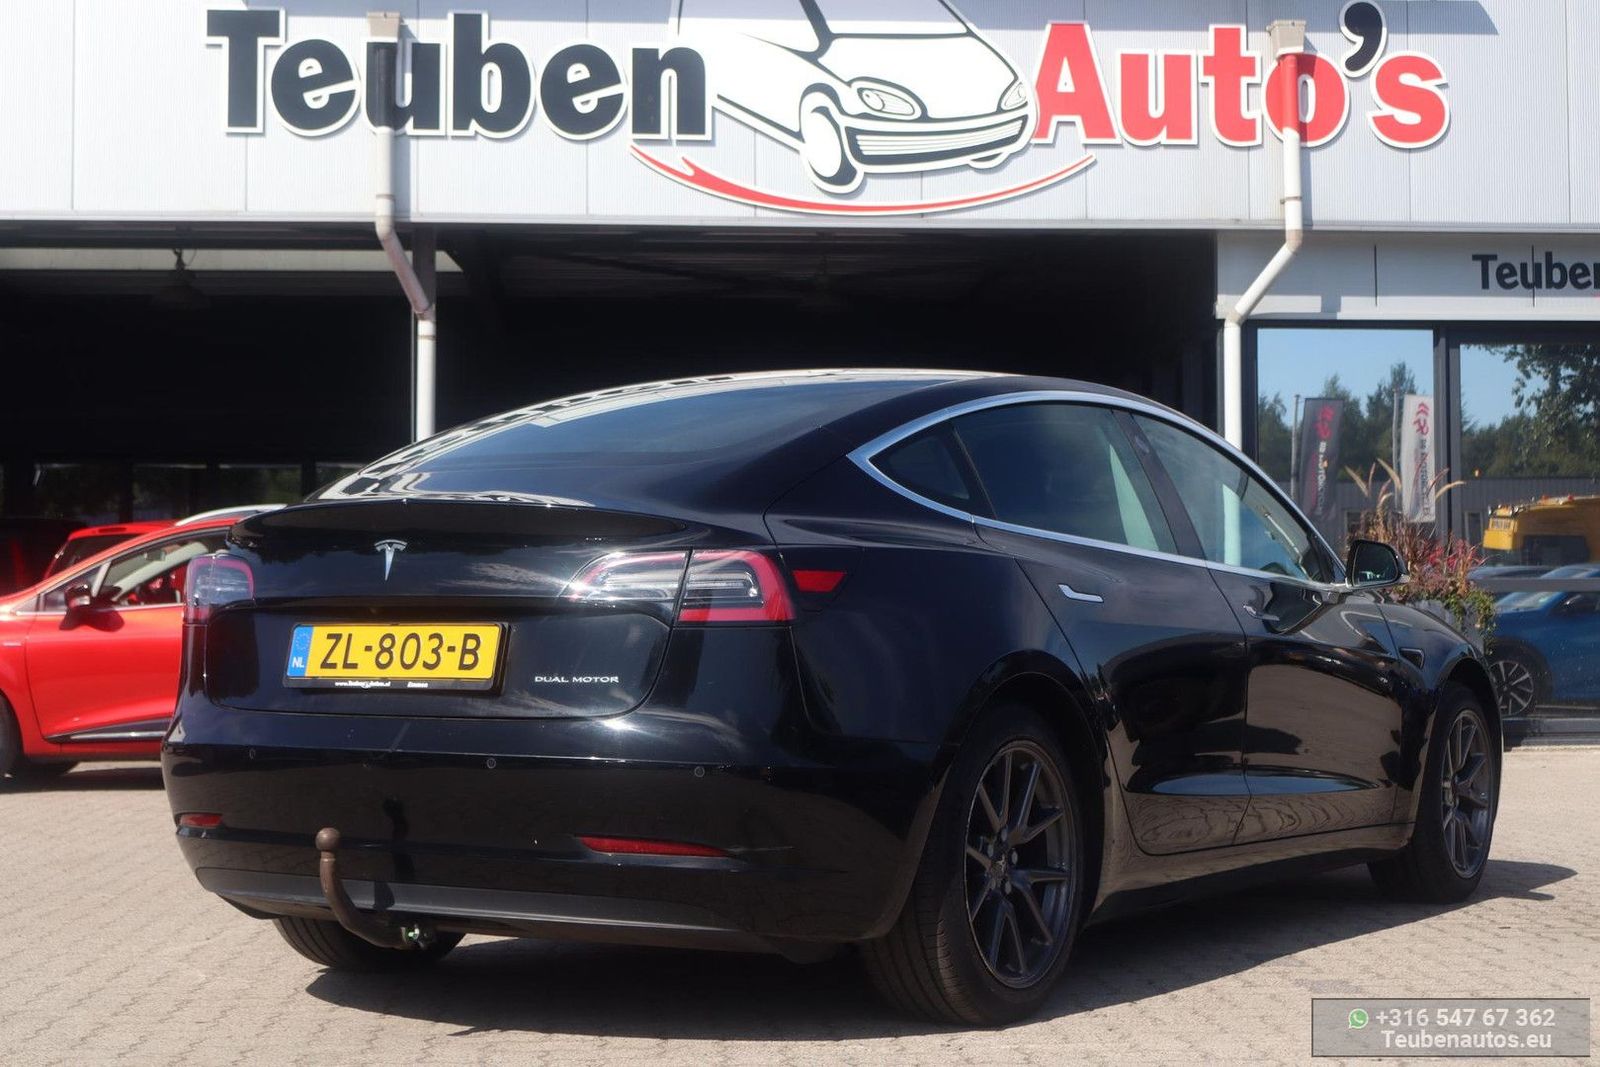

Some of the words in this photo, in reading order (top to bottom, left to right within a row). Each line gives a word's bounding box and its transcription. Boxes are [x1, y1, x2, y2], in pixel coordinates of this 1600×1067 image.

[206, 8, 709, 139] Teuben
[1031, 1, 1448, 147] Auto's
[1472, 251, 1600, 290] Teube
[292, 657, 304, 668] NL
[320, 632, 481, 671] ZL-803-B
